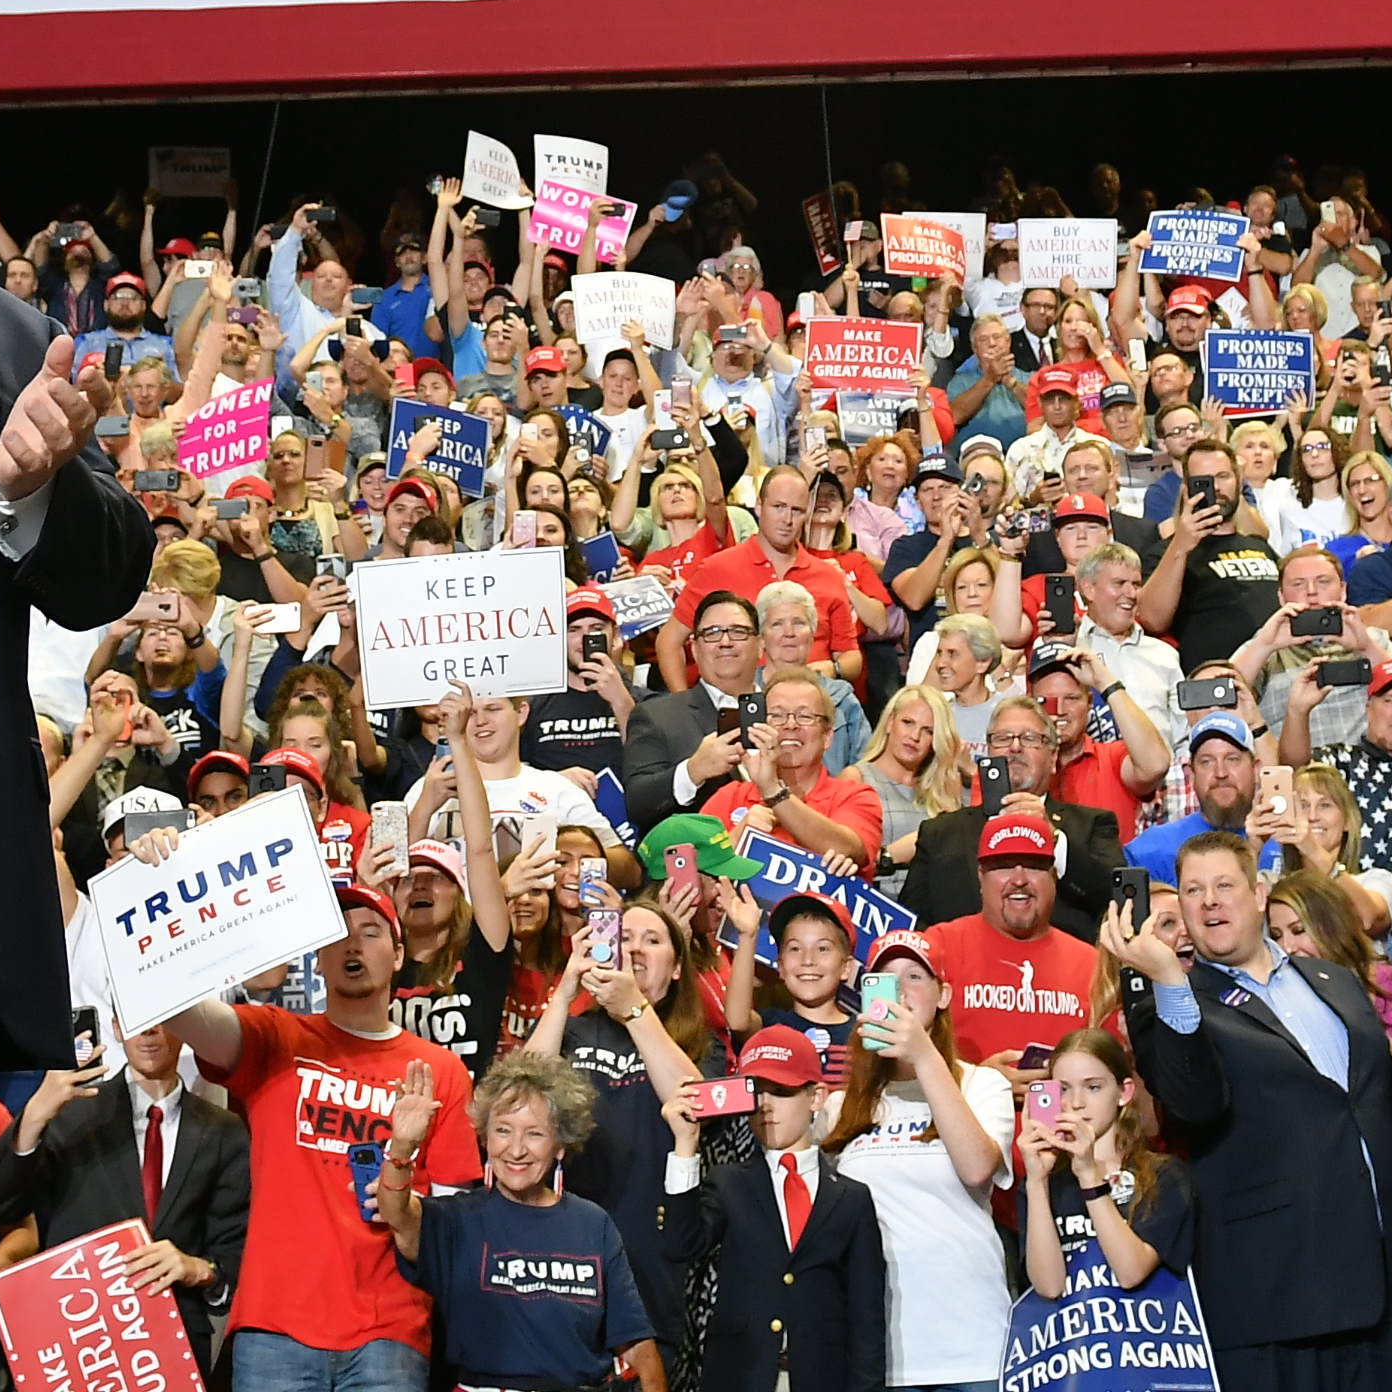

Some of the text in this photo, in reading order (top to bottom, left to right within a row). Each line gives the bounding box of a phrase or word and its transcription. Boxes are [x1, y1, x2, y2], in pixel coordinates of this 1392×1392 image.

[544, 154, 603, 171] TRUMP
[913, 226, 943, 239] MAKE
[1053, 226, 1080, 237] BUY
[1158, 218, 1237, 235] PROMISES
[1171, 229, 1217, 244] MADE
[887, 235, 966, 265] AMERICA
[1026, 239, 1110, 252] AMERICAN
[1152, 244, 1232, 263] PROMISES
[889, 251, 933, 265] PROUD
[1052, 253, 1081, 264] HIRE
[1167, 257, 1210, 272] KEPT
[1027, 266, 1109, 279] AMERICAN
[843, 330, 882, 342] MAKE
[808, 344, 916, 365] AMERICA
[1218, 339, 1304, 356] PROMISES
[814, 365, 908, 380] GREAT AGAIN
[1236, 355, 1288, 370] MADE
[1217, 373, 1305, 389] PROMISES
[1238, 388, 1285, 403] KEPT
[204, 420, 237, 441] FOR
[183, 436, 262, 474] TRUMP
[426, 576, 496, 600] KEEP
[617, 598, 670, 625] AGAIN
[369, 607, 558, 651] AMERICA
[423, 654, 509, 681] GREAT
[120, 795, 160, 813] USA
[988, 823, 1046, 849] WORLDWIDE
[115, 838, 293, 936] TRUMP
[763, 853, 895, 937] DRAIN
[138, 874, 286, 954] PENCE
[138, 956, 165, 974] MAKE
[169, 930, 215, 959] AMERICA
[219, 912, 254, 934] GREAT
[259, 894, 299, 916] AGAIN!
[877, 930, 931, 952] TRUMP
[964, 985, 1018, 1011] HOOKED
[1017, 984, 1035, 1012] ON
[297, 1068, 396, 1117] TRUM
[94, 1241, 150, 1340] AGAIN
[1006, 1297, 1201, 1371] AMERICA
[1006, 1342, 1208, 1392] STRONG AGAIN
